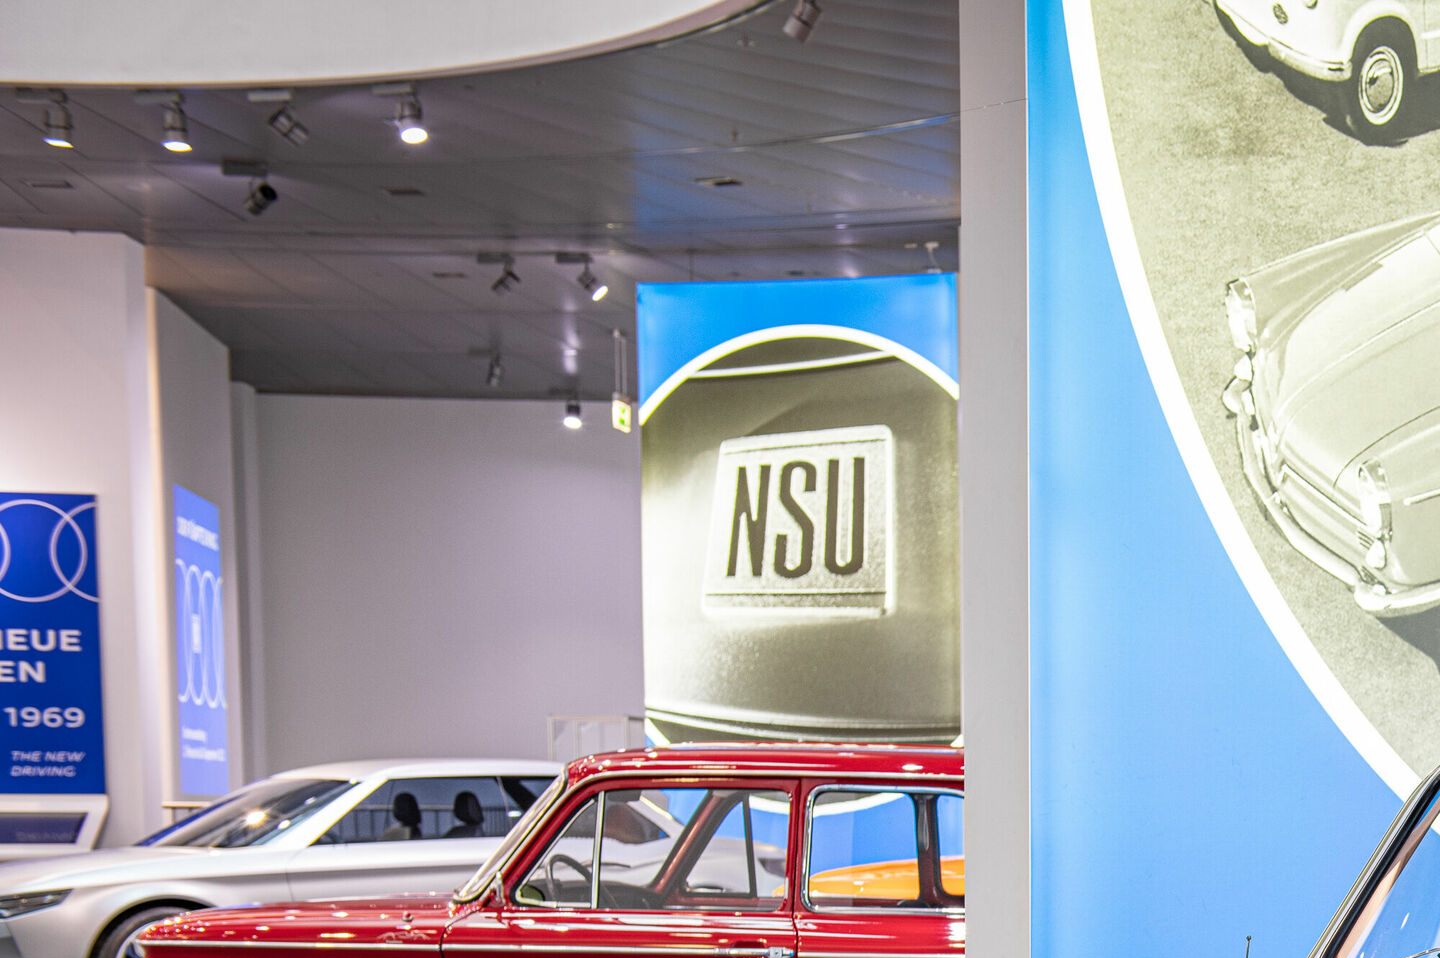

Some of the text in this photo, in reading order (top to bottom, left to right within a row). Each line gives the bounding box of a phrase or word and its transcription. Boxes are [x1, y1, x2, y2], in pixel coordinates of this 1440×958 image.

[726, 456, 866, 579] NSU
[0, 628, 83, 652] EUE
[3, 706, 86, 729] 1969
[11, 750, 86, 762] THE NEW
[10, 765, 77, 777] DRIVING
